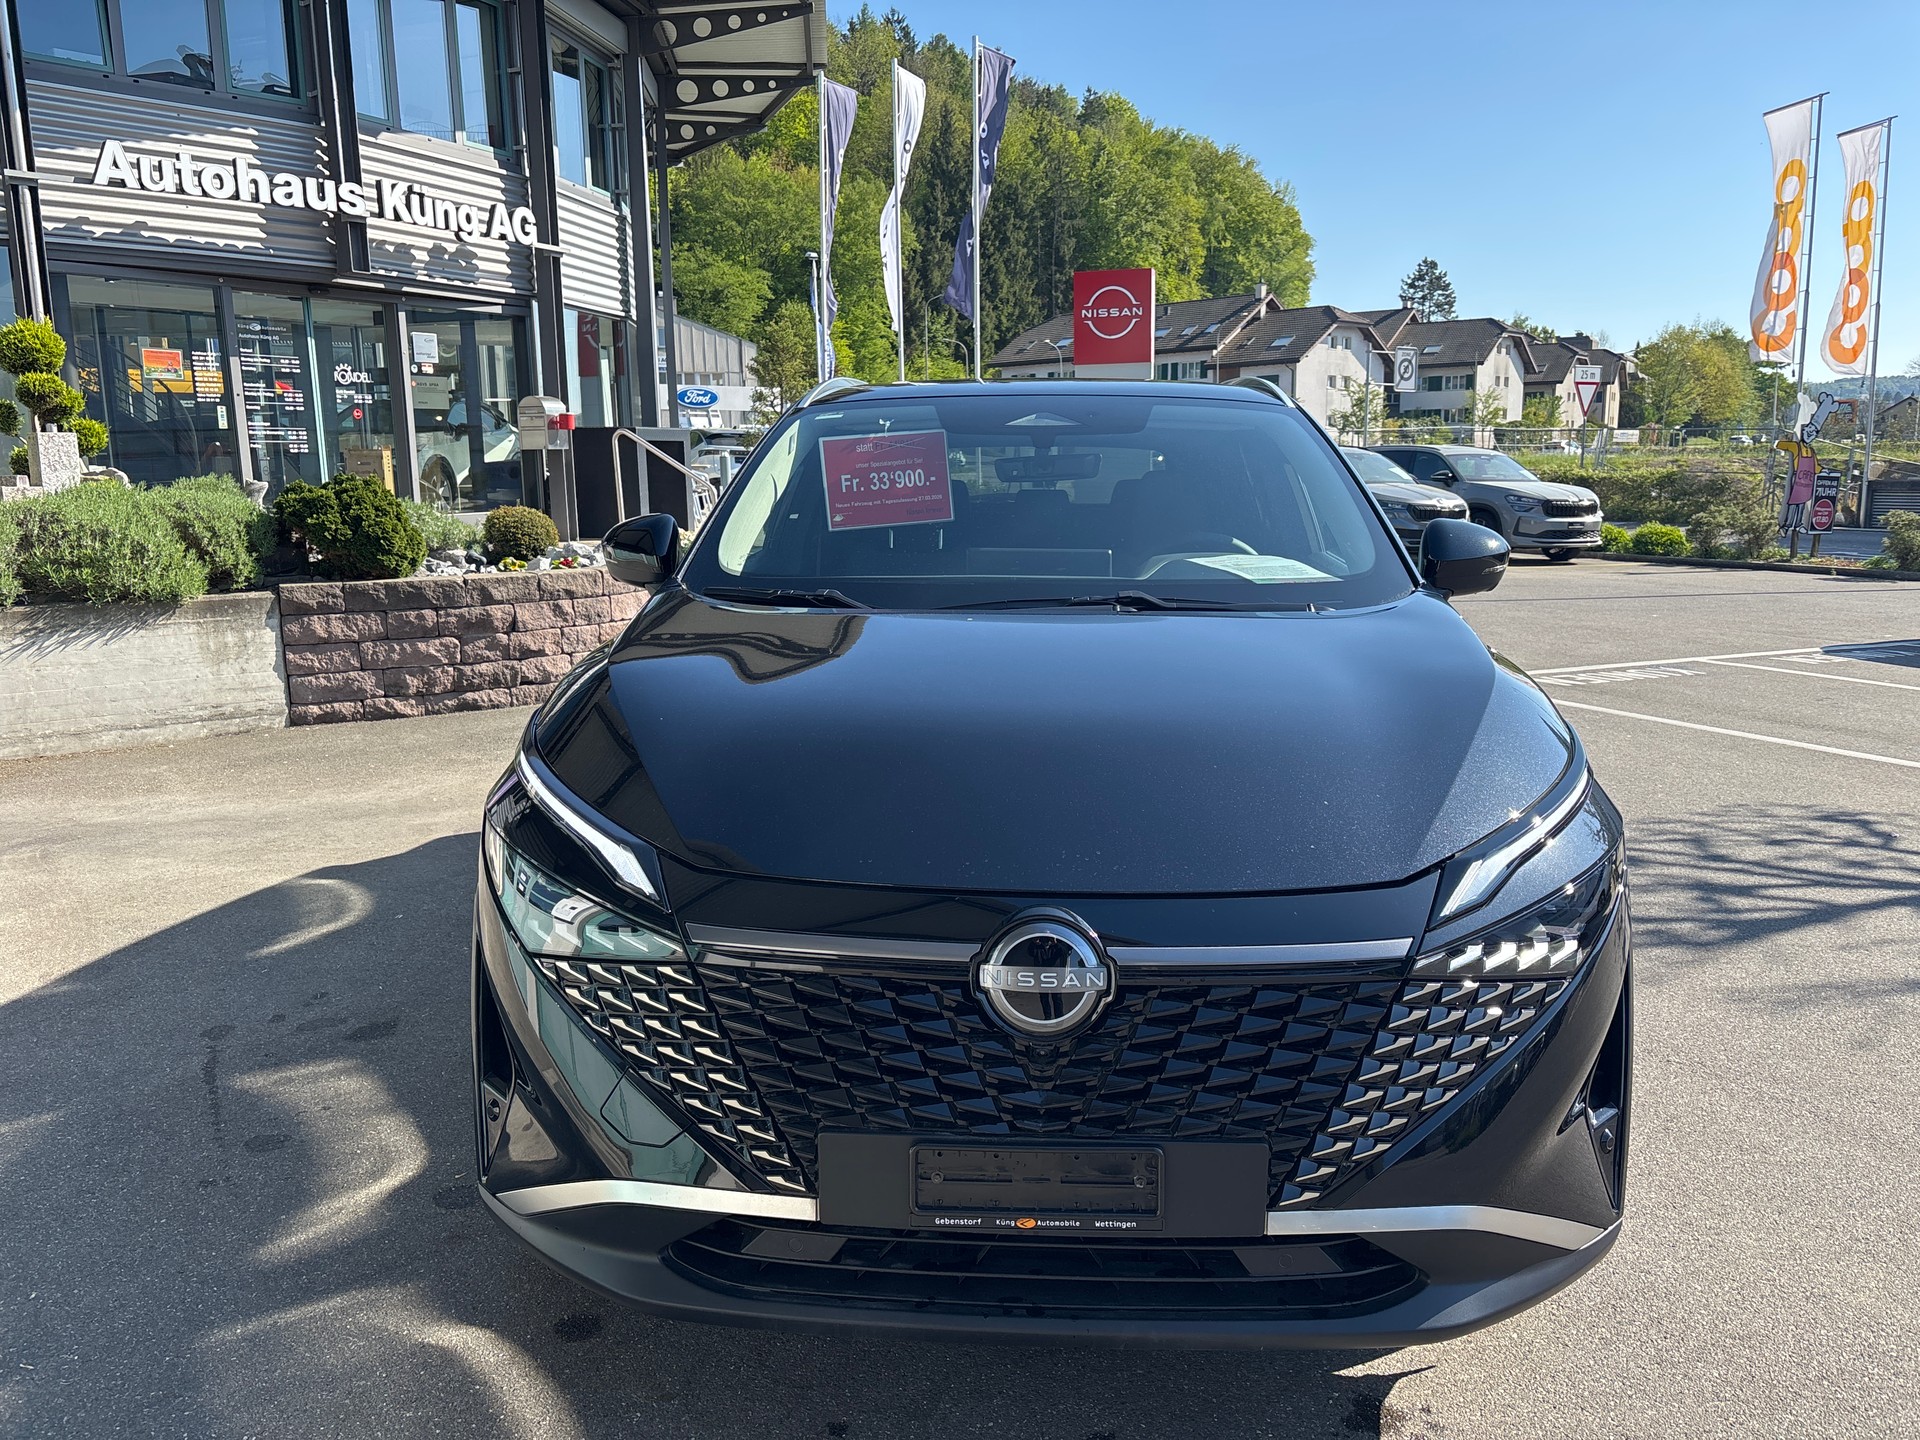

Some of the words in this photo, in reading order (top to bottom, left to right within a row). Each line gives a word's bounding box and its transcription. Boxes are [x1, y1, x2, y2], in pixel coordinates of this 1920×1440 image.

[93, 139, 367, 217] Autohaus
[378, 178, 478, 243] Küng
[489, 203, 537, 246] AG
[1752, 158, 1806, 352] coop
[1828, 180, 1875, 364] coop
[1081, 306, 1143, 318] NISSAN
[333, 369, 375, 385] RONDELL
[1580, 369, 1588, 380] 25
[1590, 372, 1596, 380] m
[684, 390, 711, 403] Ford
[855, 443, 874, 453] statt
[840, 475, 864, 493] Fr.
[982, 967, 1105, 988] NISSAN
[935, 1217, 982, 1226] Gebenstorf
[996, 1218, 1015, 1228] Küng
[1037, 1219, 1080, 1227] Automobile
[1095, 1220, 1137, 1229] Wettingen
